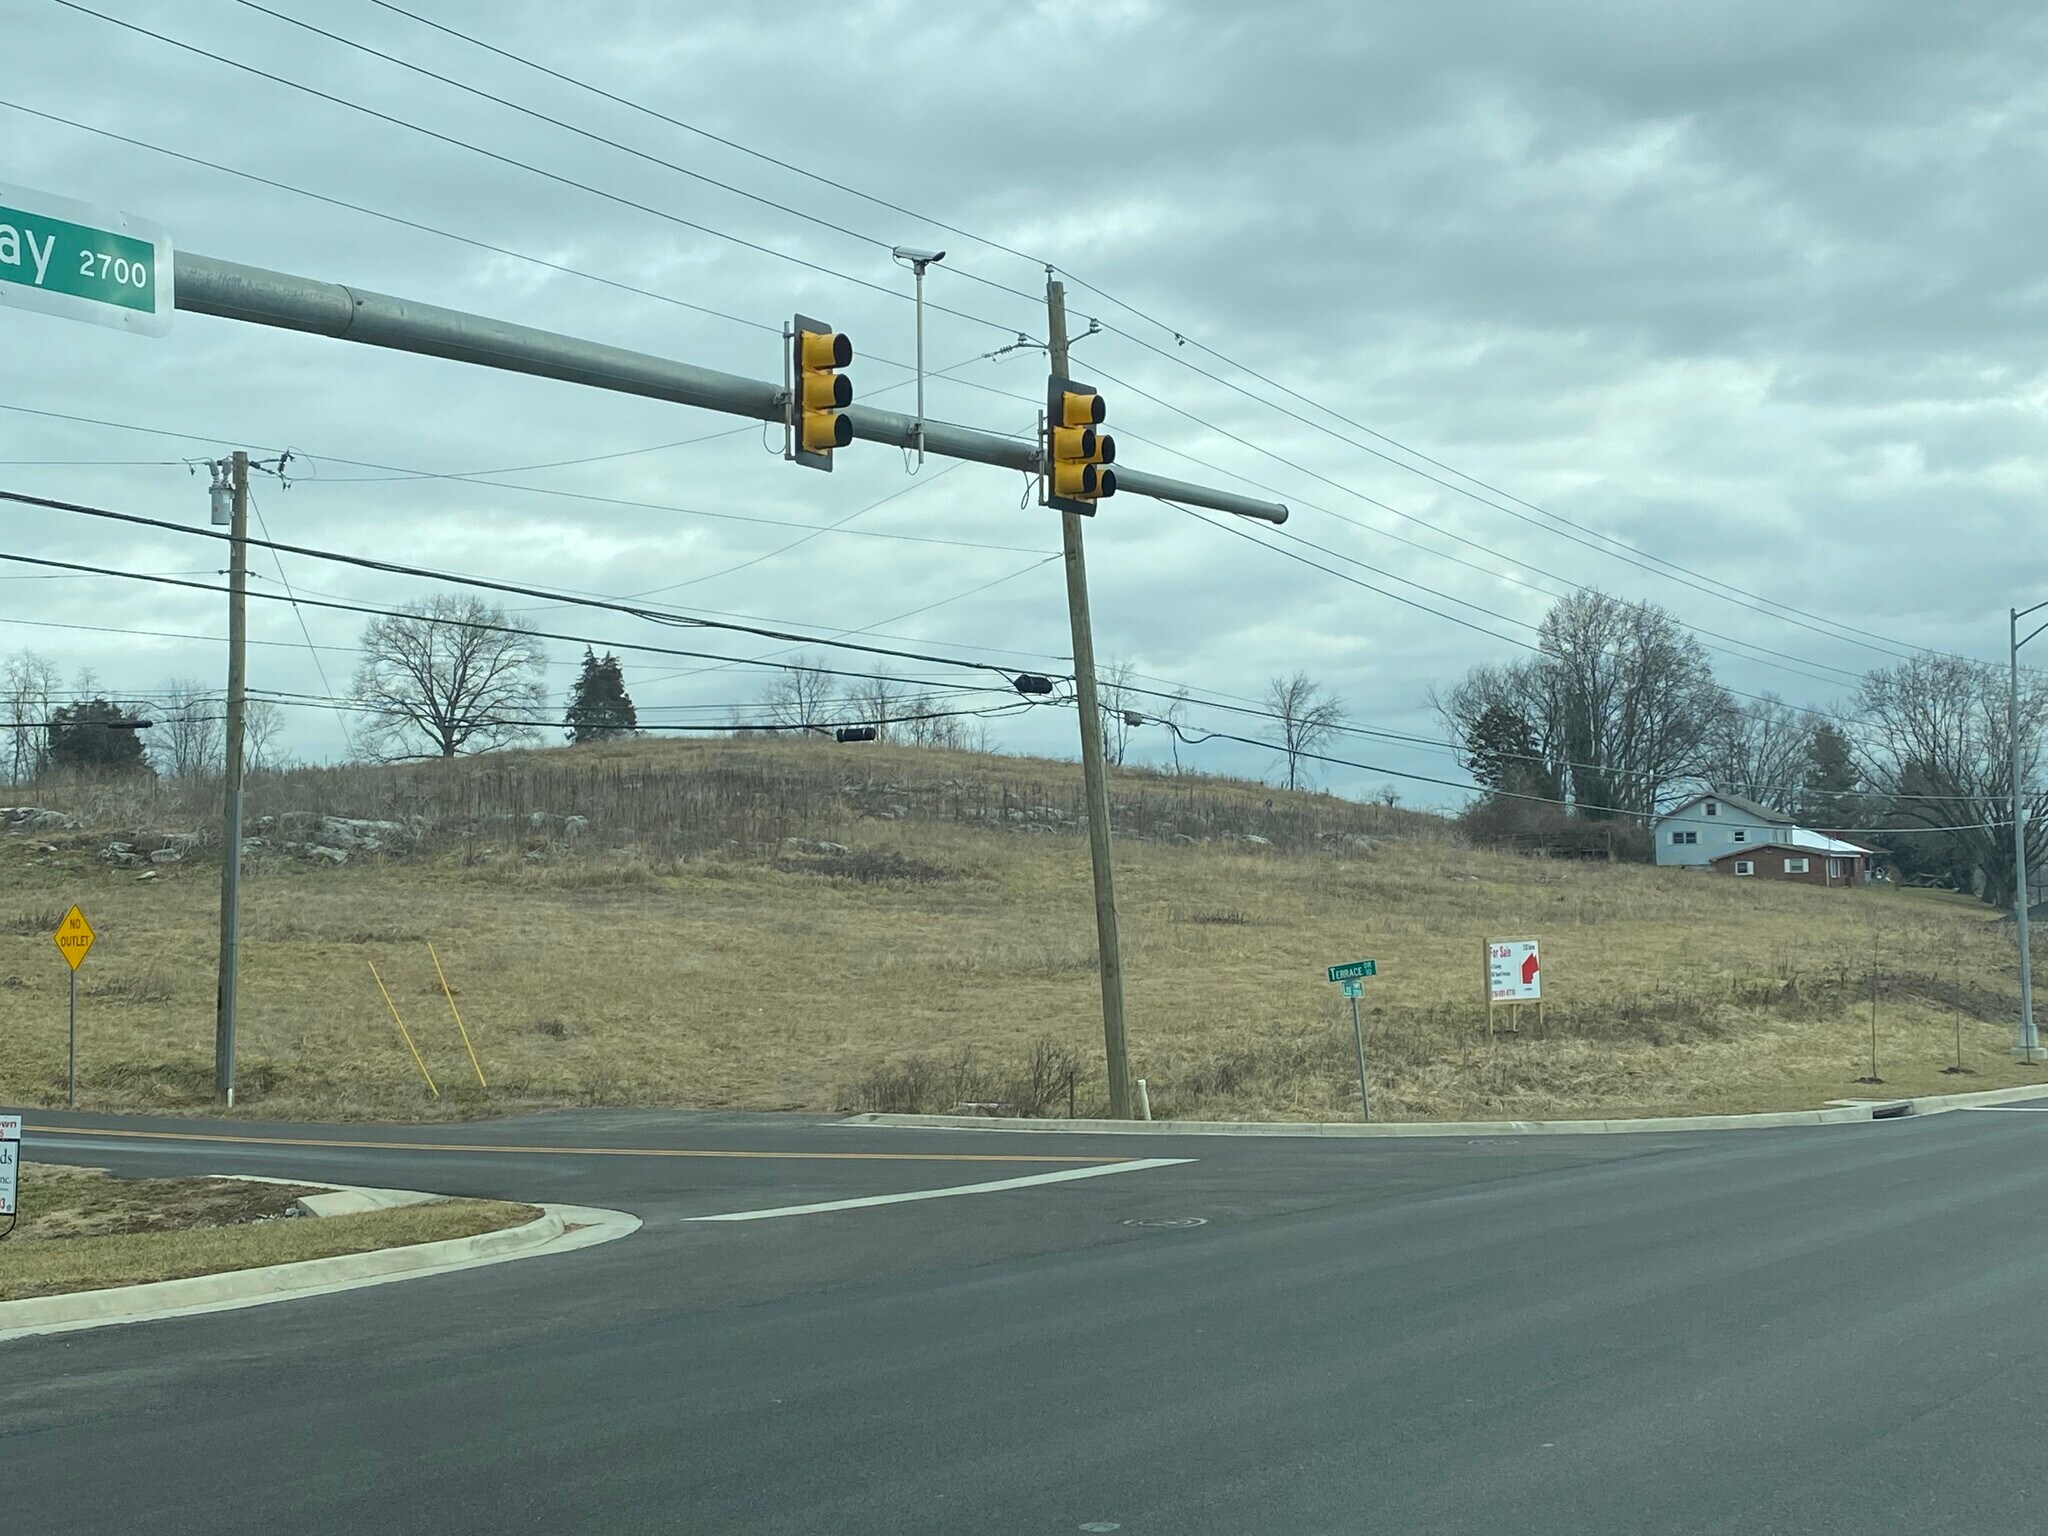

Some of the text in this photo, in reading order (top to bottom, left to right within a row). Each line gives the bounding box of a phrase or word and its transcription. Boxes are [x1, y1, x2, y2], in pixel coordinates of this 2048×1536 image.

[0, 223, 147, 288] ay 2700
[70, 918, 81, 929] NO
[60, 935, 90, 947] OUTLET
[1500, 945, 1511, 958] Sale
[1330, 967, 1363, 980] TERRACE
